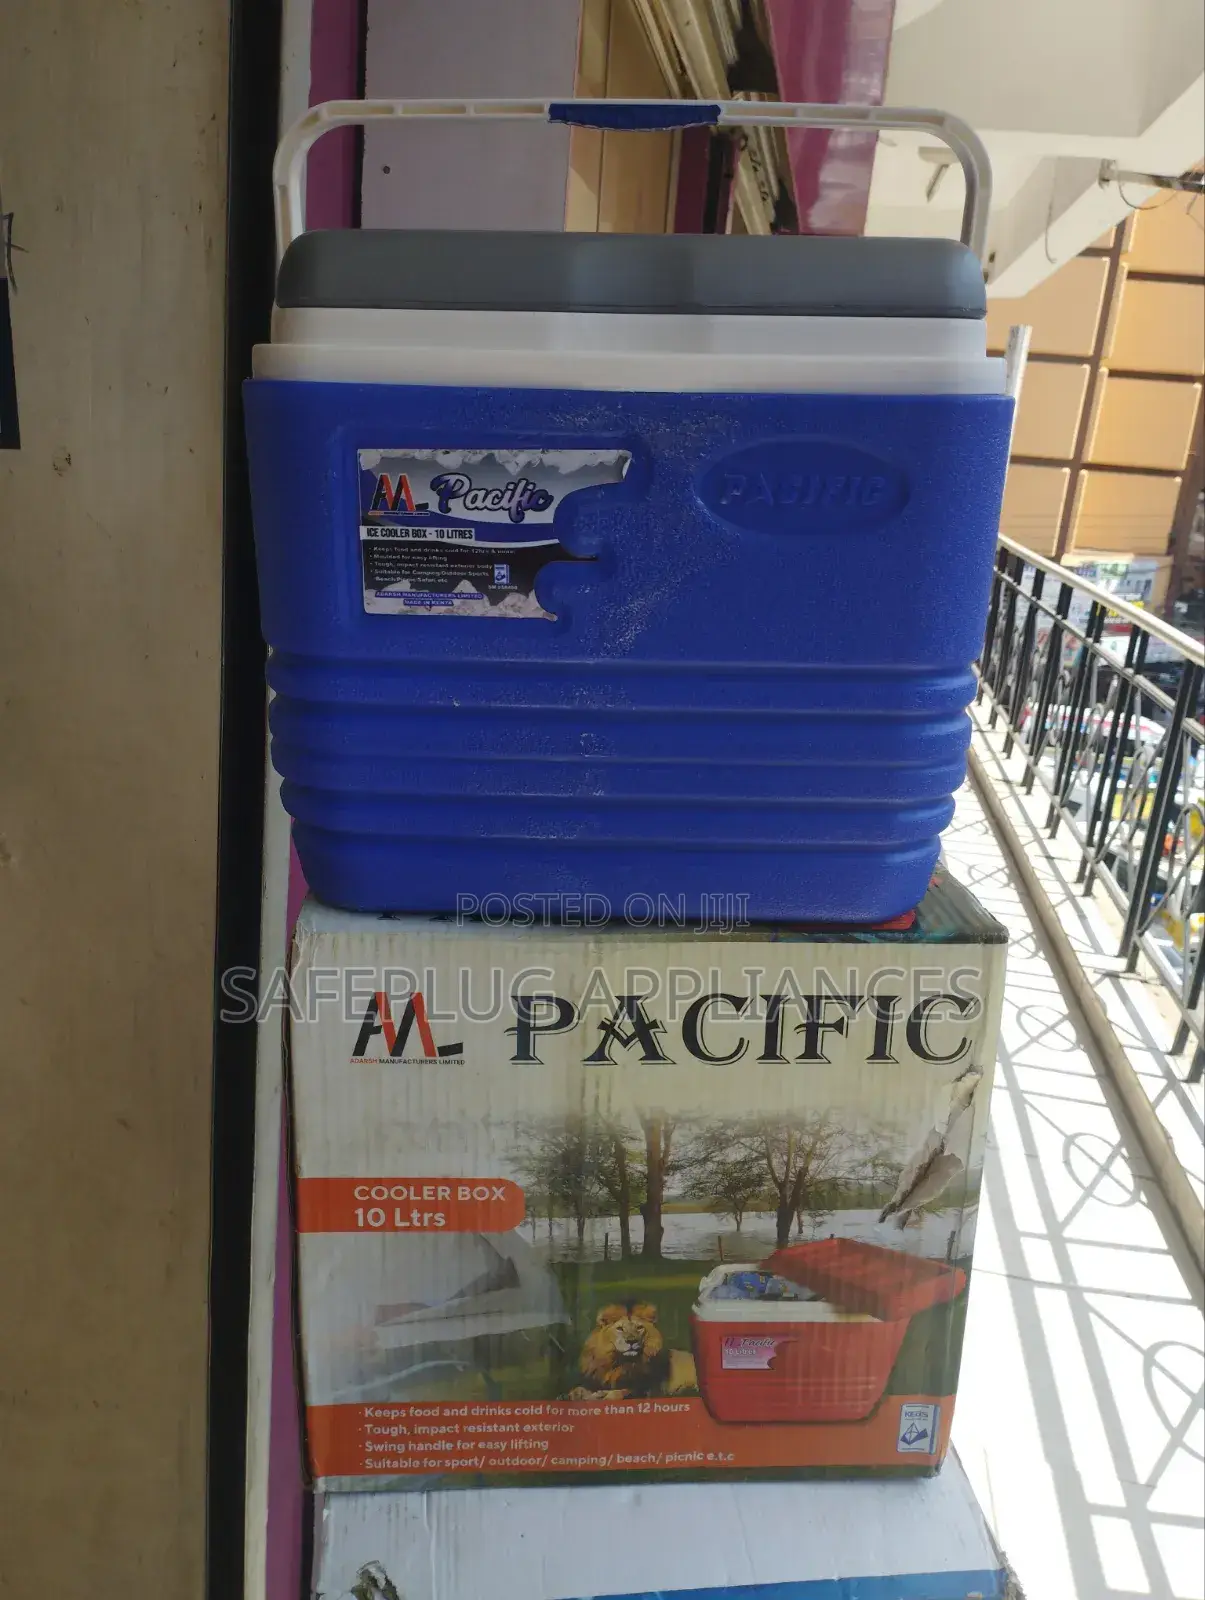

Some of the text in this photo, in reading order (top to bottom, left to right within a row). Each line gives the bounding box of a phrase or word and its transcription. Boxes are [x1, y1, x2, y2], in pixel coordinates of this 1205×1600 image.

[430, 472, 554, 523] Pacific
[366, 527, 380, 538] ICE
[380, 527, 410, 539] COOLER
[411, 528, 428, 539] BOX
[435, 528, 445, 539] 10
[446, 529, 473, 540] LITRES
[504, 991, 980, 1067] PACIFIC
[349, 1057, 466, 1066] ADARSH MANUFACTURERS LIMITED
[353, 1185, 506, 1202] COOLER BOX
[353, 1207, 446, 1228] 10 Ltrs
[364, 1402, 691, 1420] Keeps food and drinks cold for more than 12 hours
[364, 1420, 575, 1437] Tough, impact resistant exterior
[364, 1438, 549, 1454] Swing handle for easy lifting
[364, 1450, 736, 1470] Suitable for sport/ outdoor/ camping/ beach/ picnic e.t.c
